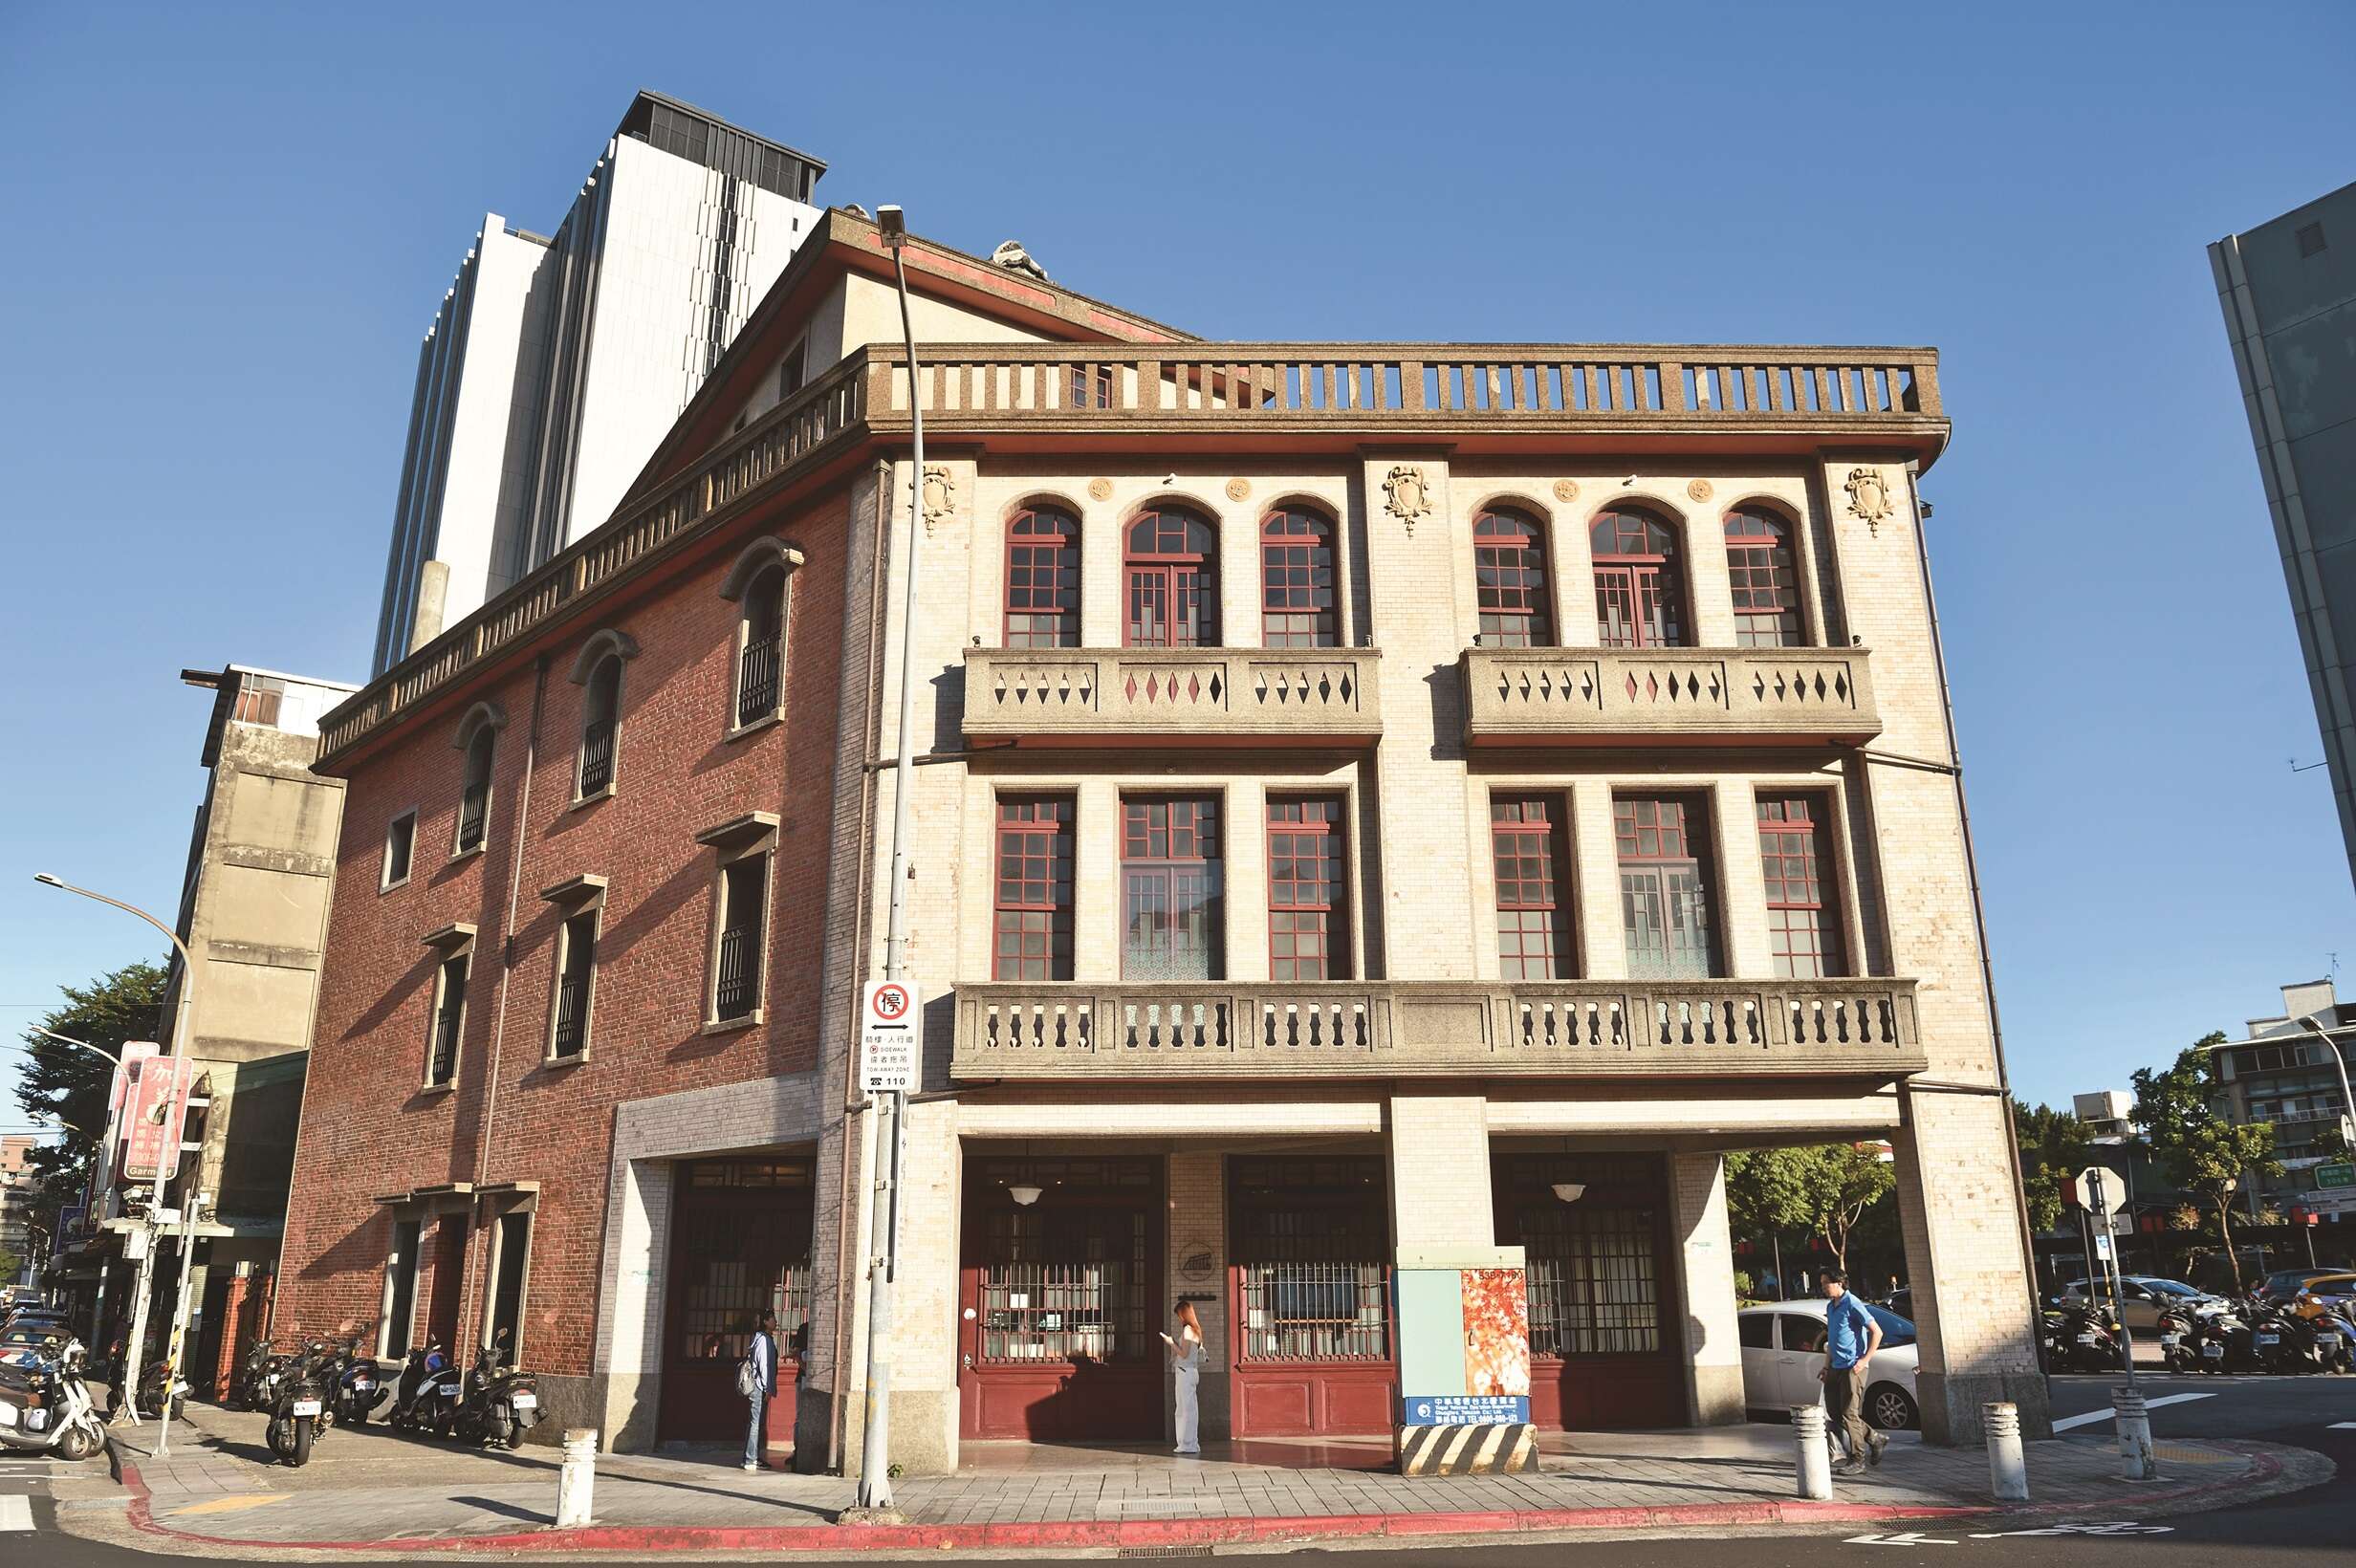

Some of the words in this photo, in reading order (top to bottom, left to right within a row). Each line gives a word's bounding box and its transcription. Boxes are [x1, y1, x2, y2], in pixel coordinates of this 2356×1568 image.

[882, 992, 901, 1013] 停
[885, 1077, 905, 1085] 110
[129, 1166, 172, 1177] Garmt
